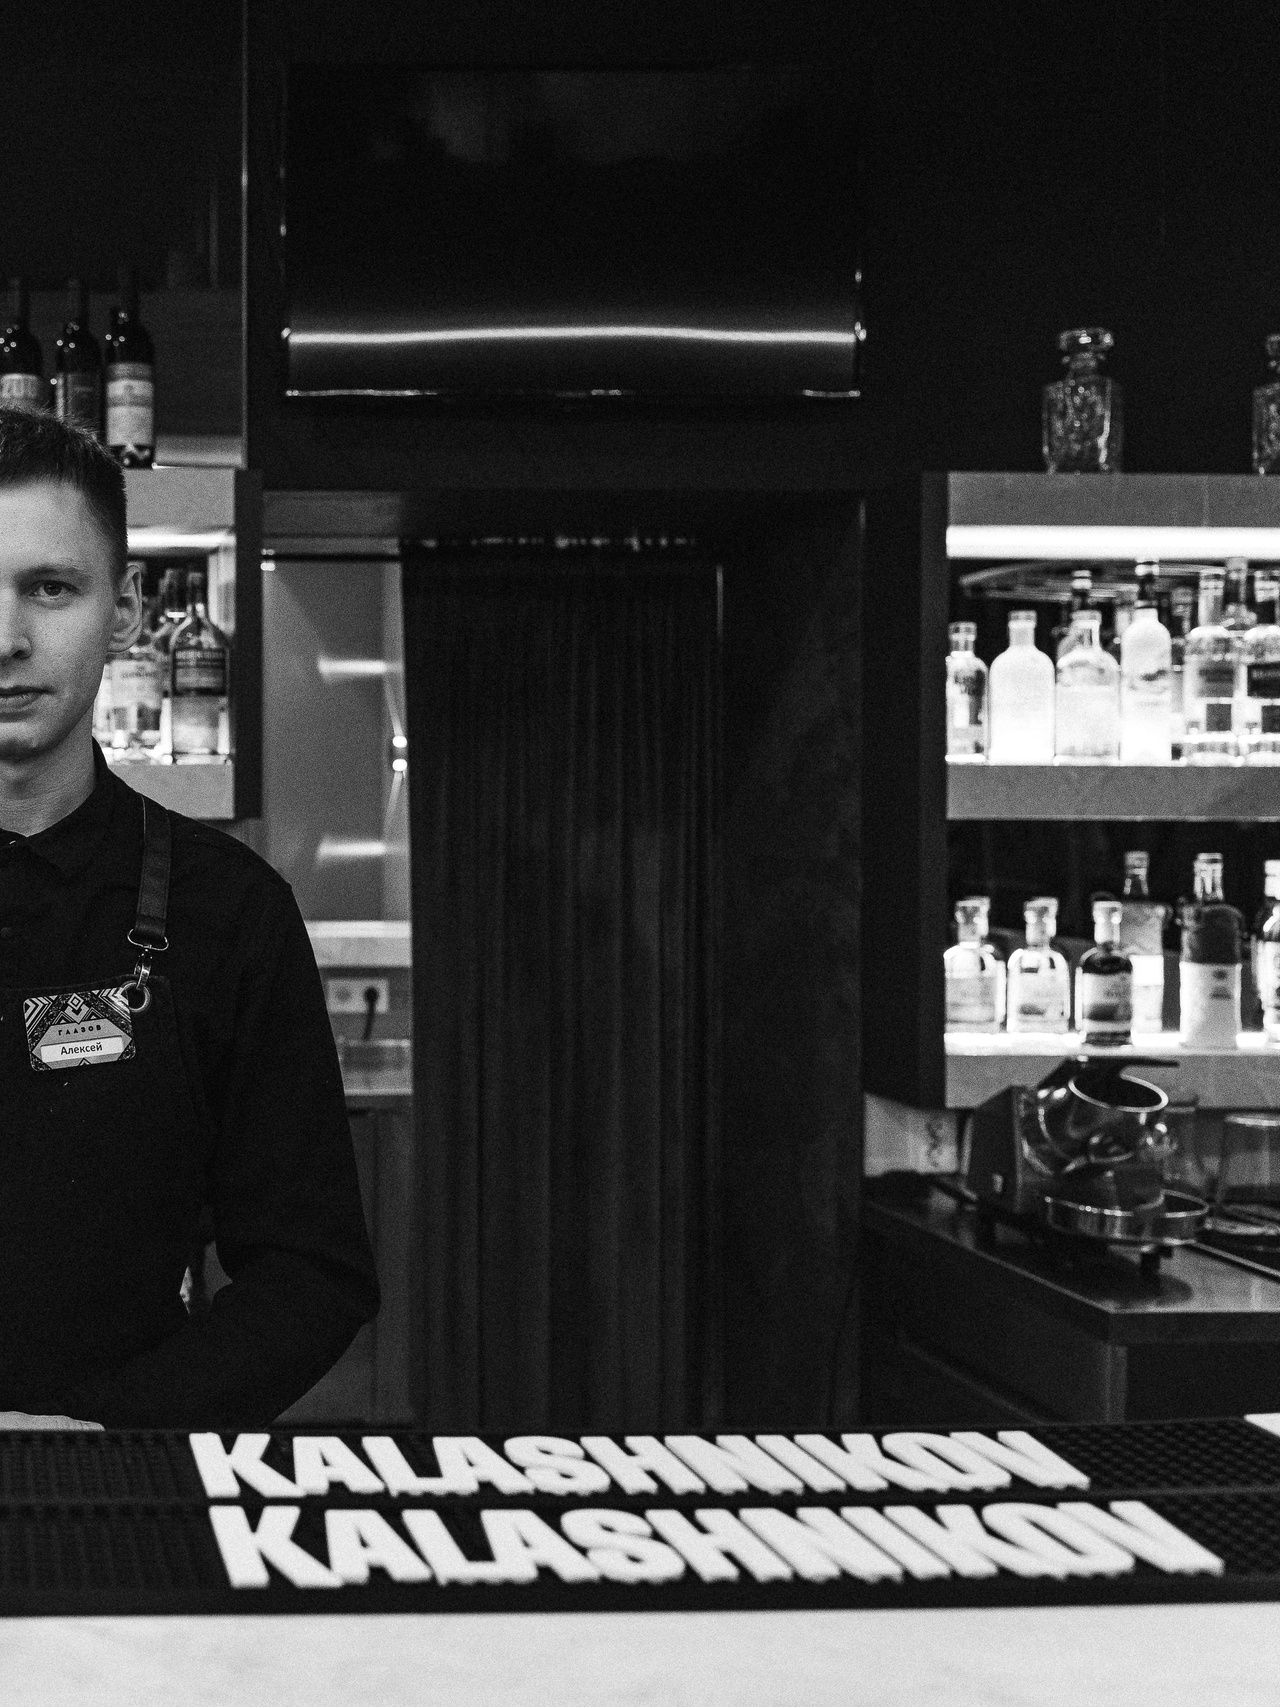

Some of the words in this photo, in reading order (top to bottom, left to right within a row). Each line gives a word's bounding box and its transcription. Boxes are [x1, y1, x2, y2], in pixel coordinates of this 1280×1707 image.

[60, 1042, 103, 1055] Алексей
[188, 1431, 1091, 1498] KALASHNIKOV
[208, 1500, 1225, 1589] KALASHNIKOV
